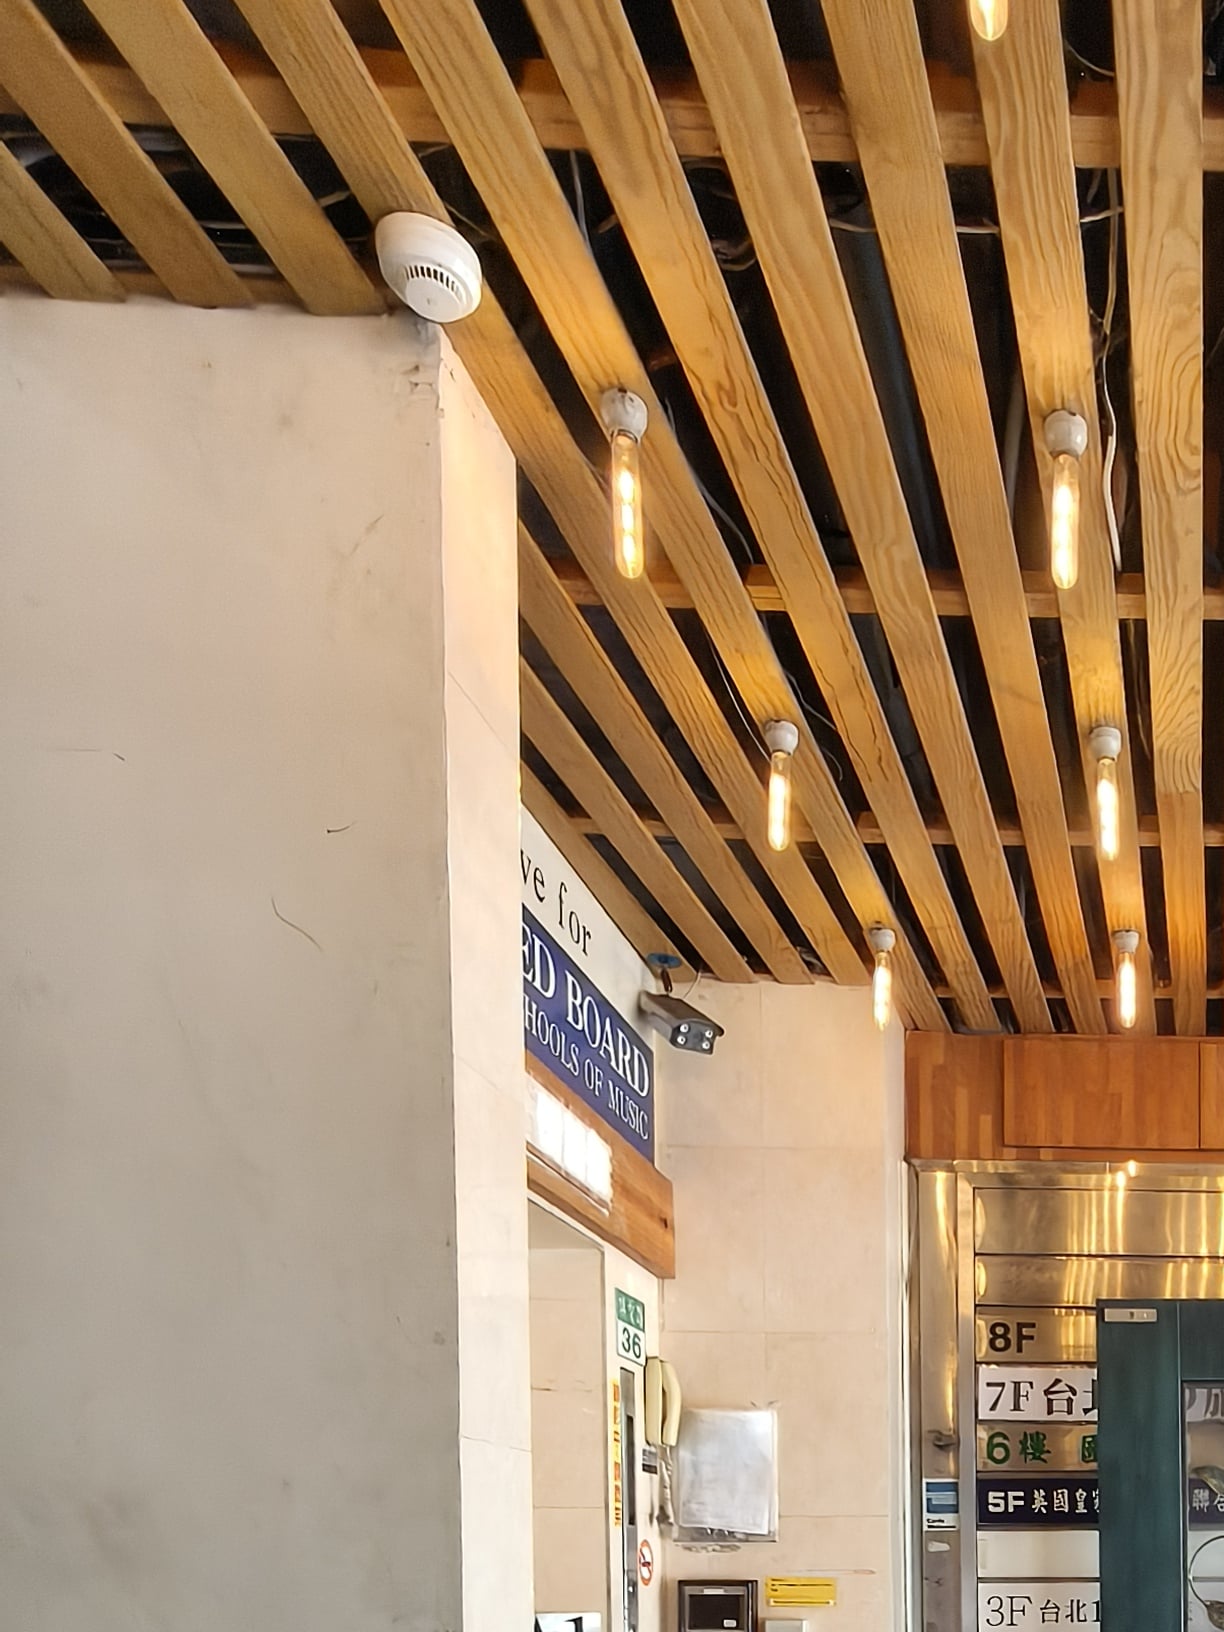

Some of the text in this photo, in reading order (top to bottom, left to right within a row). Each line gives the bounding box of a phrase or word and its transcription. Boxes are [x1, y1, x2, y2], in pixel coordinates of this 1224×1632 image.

[558, 881, 592, 957] for
[564, 968, 650, 1098] BOARD
[584, 1057, 604, 1098] OF
[608, 1079, 650, 1141] MUSIC
[621, 1326, 642, 1359] 36
[988, 1321, 1037, 1354] 8F
[985, 1380, 1035, 1412] 7F
[987, 1490, 1026, 1514] 5F
[985, 1594, 1033, 1627] 3F
